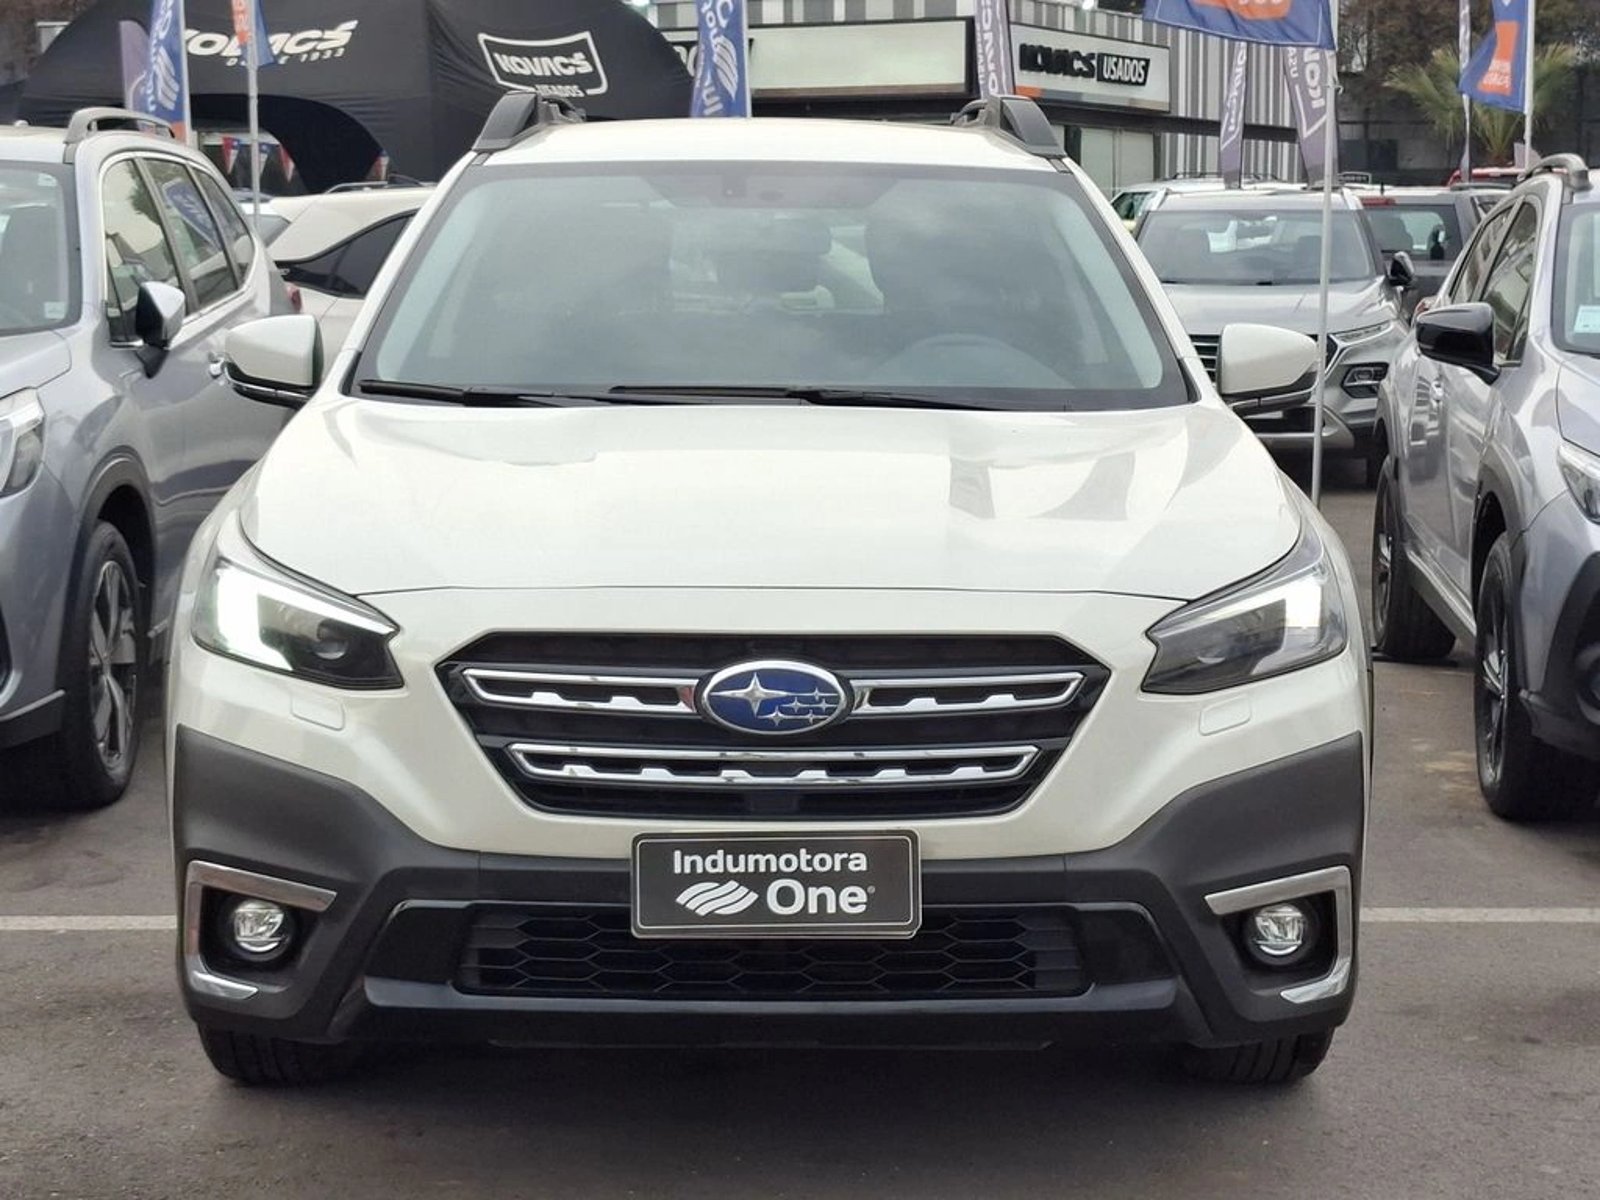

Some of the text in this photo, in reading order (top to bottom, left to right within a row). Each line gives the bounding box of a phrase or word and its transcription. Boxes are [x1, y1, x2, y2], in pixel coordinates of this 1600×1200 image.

[493, 52, 594, 76] KOVACS
[1102, 55, 1147, 84] USADOS
[673, 847, 867, 874] Indumotora
